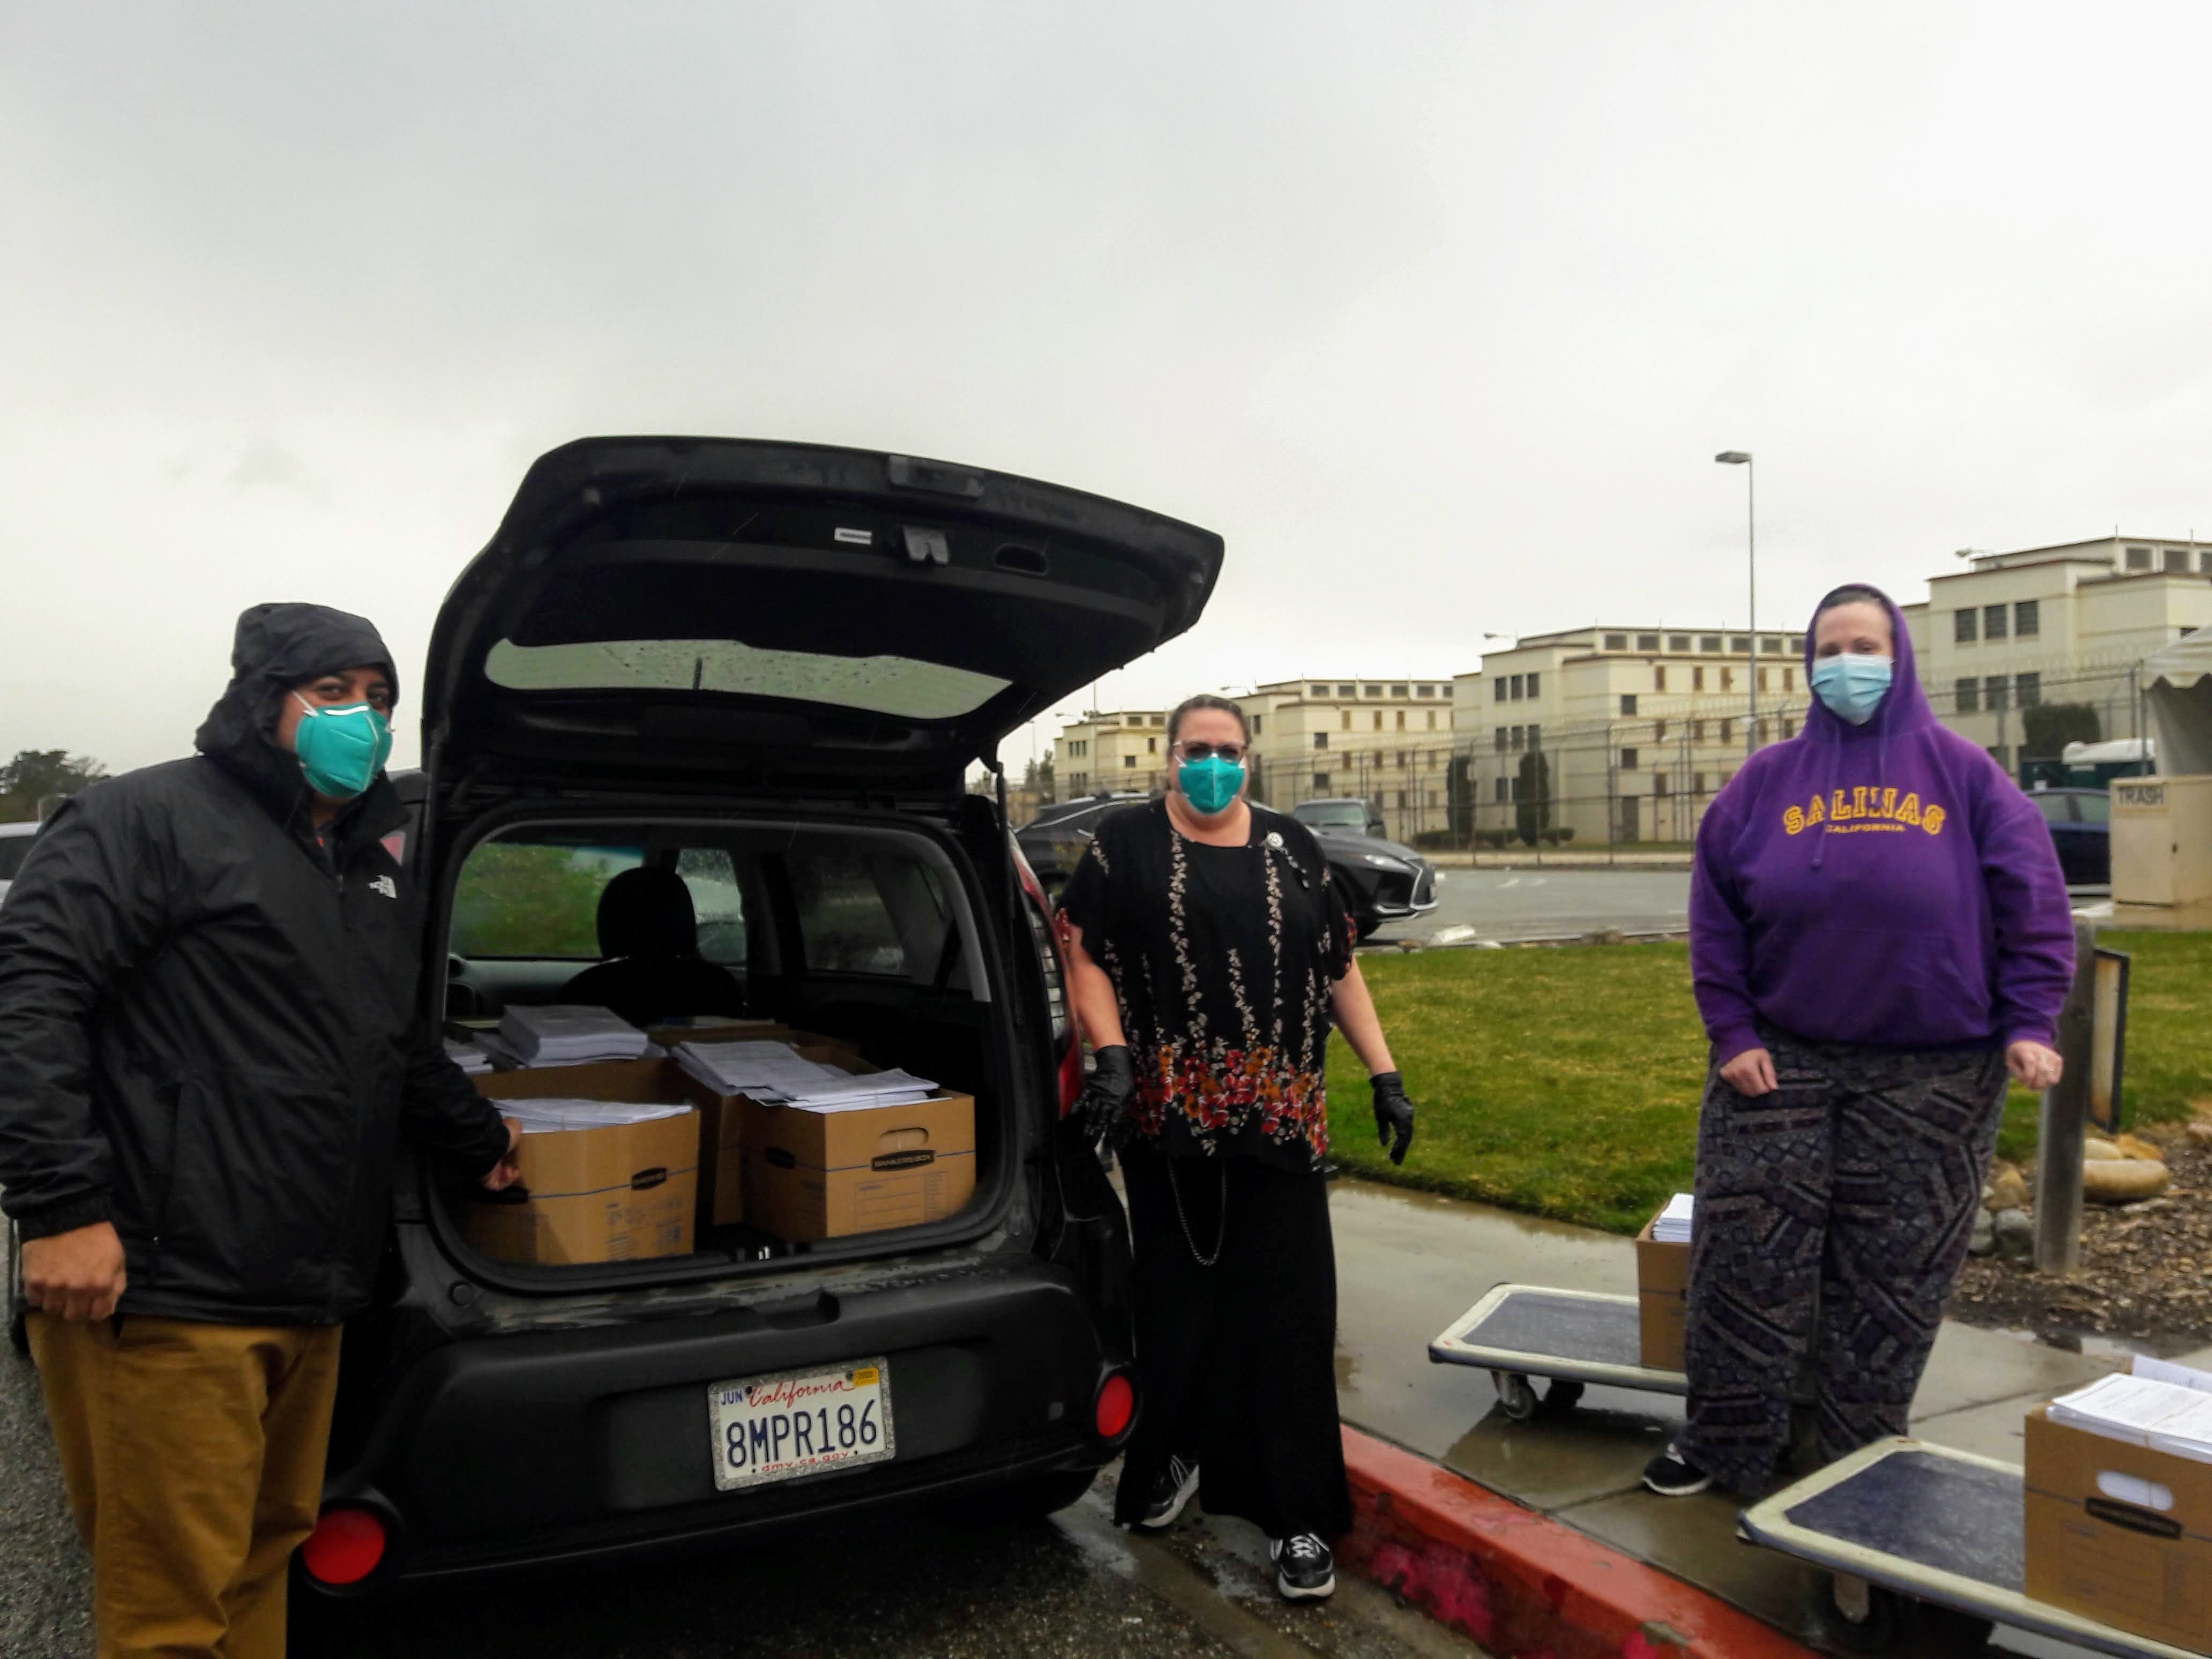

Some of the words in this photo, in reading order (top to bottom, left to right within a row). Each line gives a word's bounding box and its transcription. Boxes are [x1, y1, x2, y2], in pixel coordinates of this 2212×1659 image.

[2117, 785, 2164, 806] TRASH
[720, 1391, 743, 1406] JUN
[749, 1380, 855, 1409] California
[726, 1399, 877, 1468] 8MPR186
